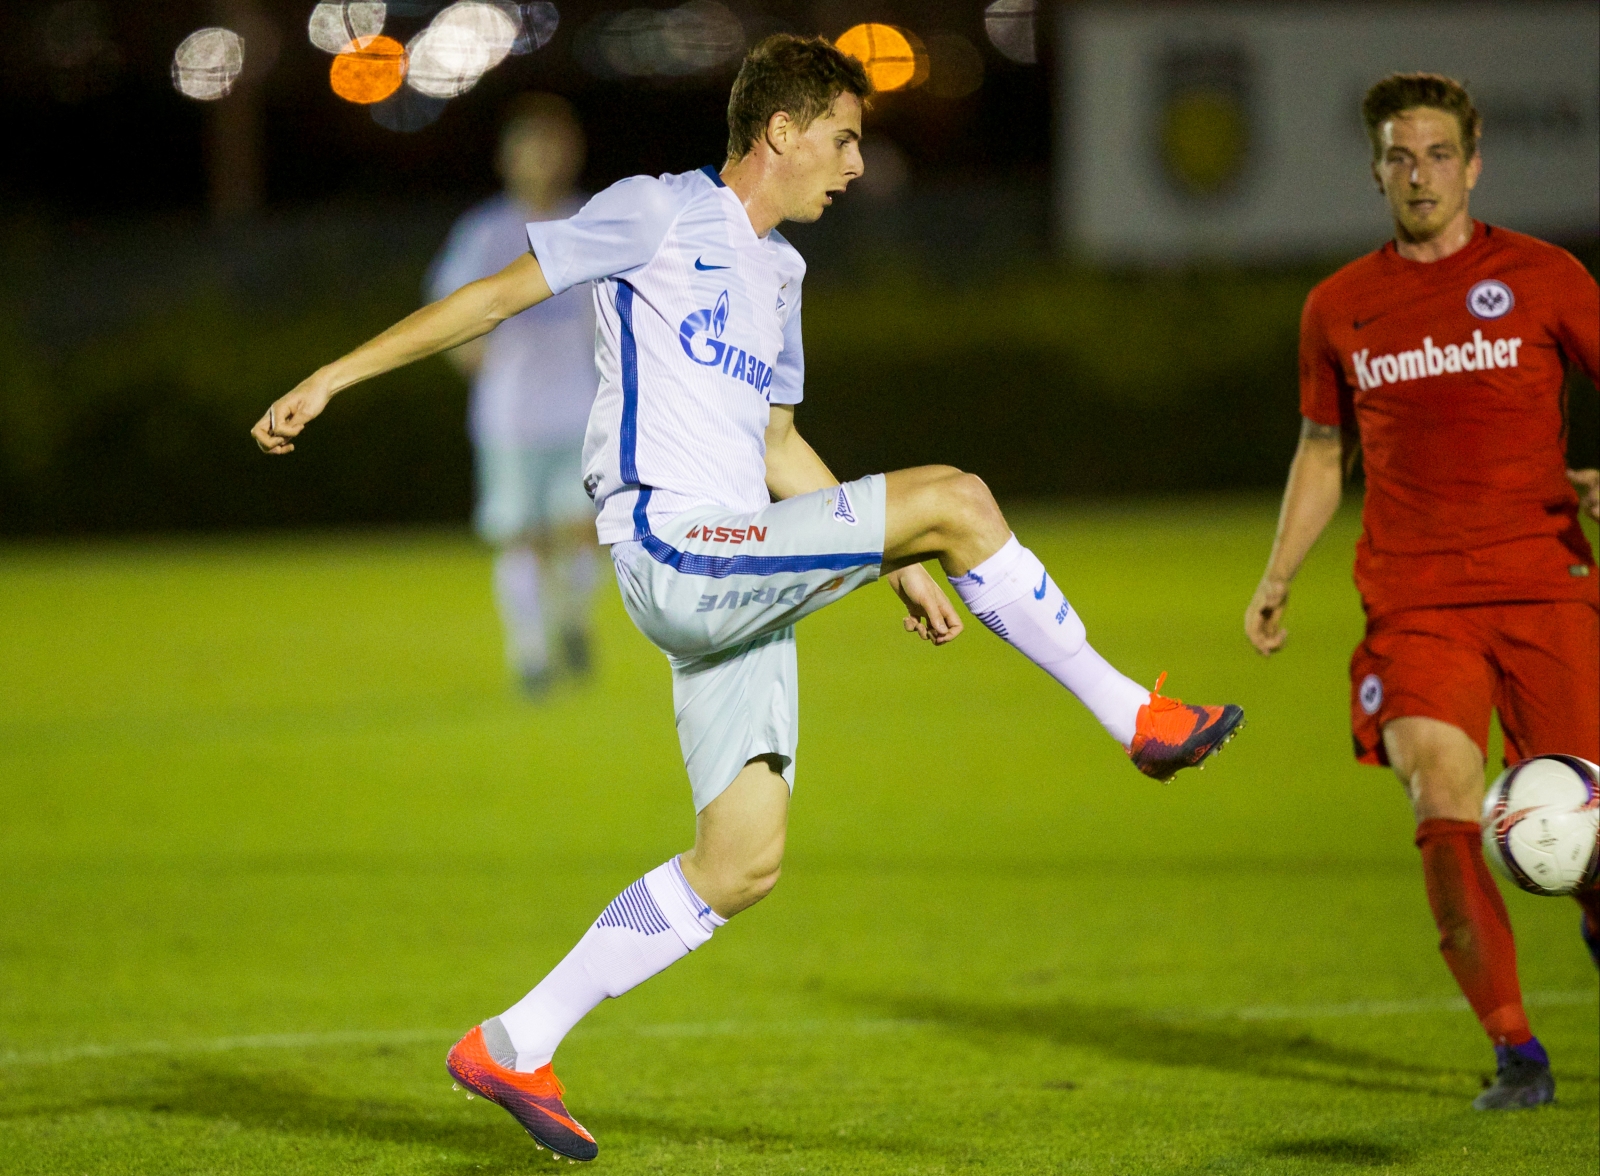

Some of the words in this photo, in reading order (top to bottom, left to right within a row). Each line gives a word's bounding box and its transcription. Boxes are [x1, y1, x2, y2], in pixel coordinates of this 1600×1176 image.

[722, 344, 773, 402] ГАЗПР
[1352, 329, 1522, 391] Krombacher
[686, 525, 768, 544] NSSAN
[696, 583, 809, 612] DRIVE
